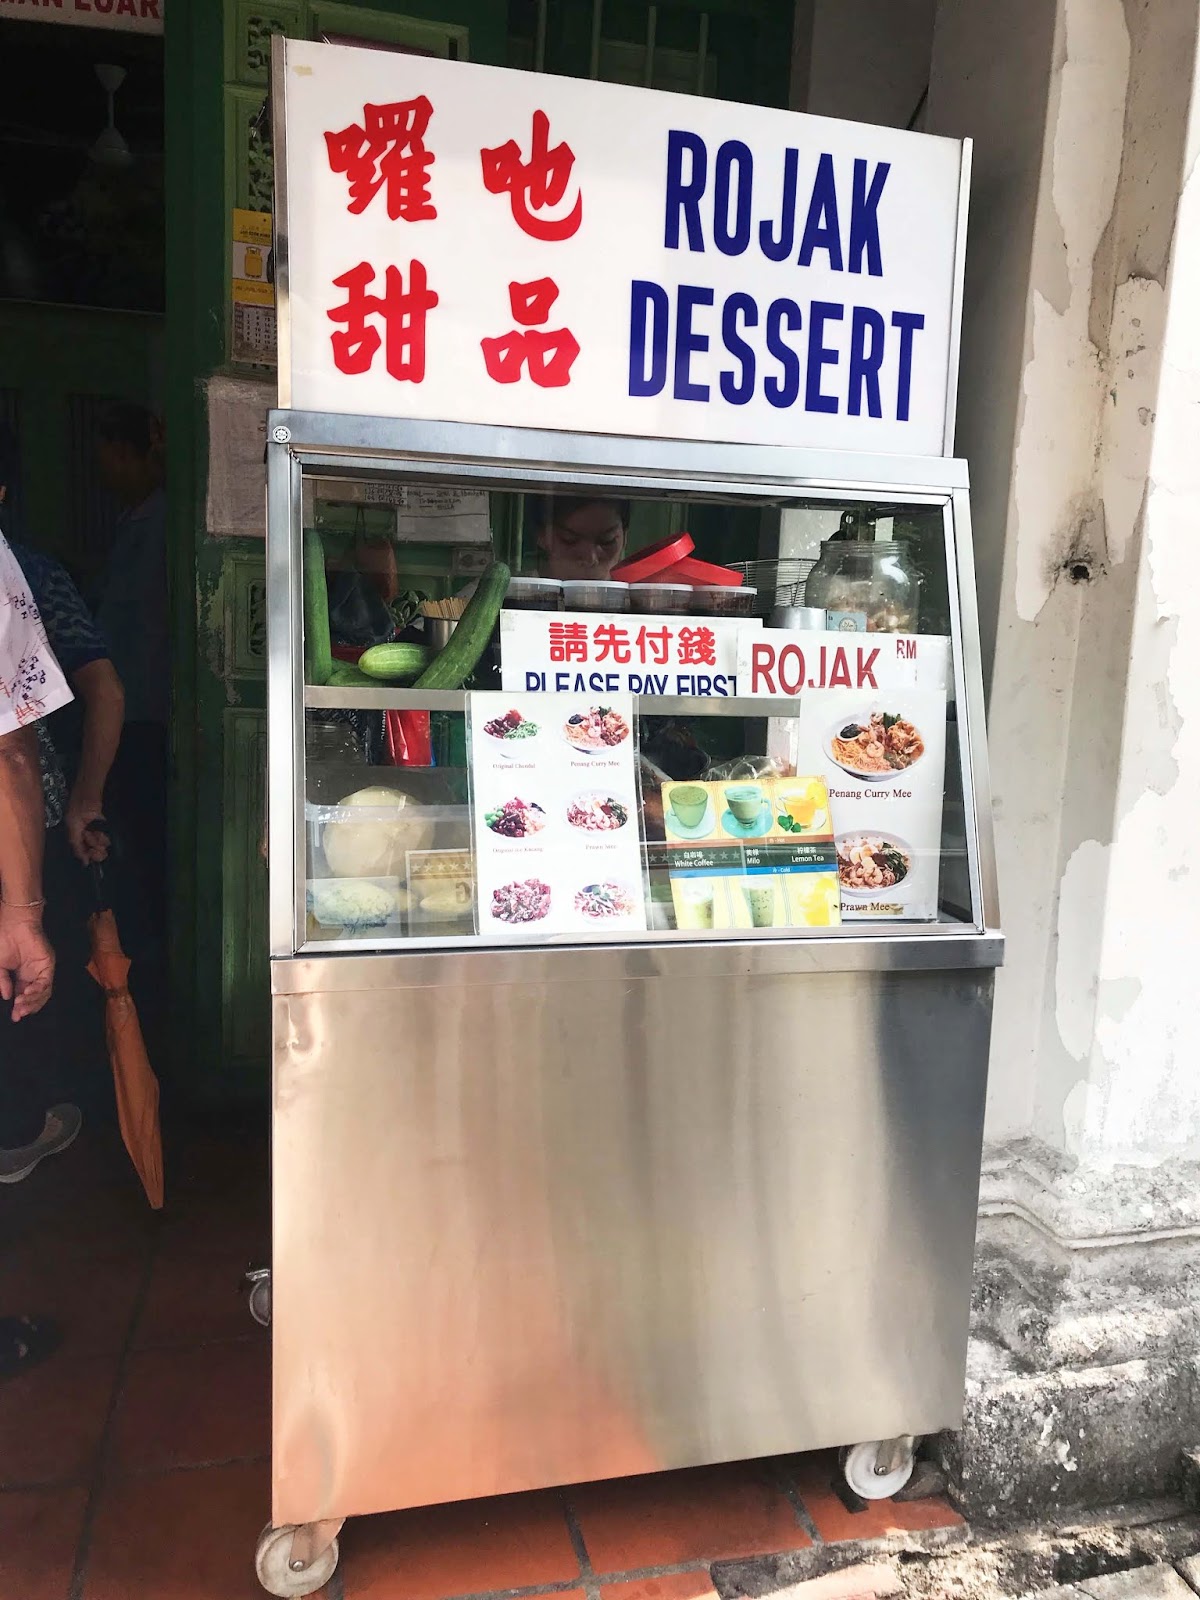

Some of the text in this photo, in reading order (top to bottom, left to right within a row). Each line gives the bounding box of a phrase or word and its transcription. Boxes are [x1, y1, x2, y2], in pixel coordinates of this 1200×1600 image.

[665, 130, 891, 277] ROJAK
[326, 259, 581, 389] 甜品
[628, 280, 925, 422] DESSERT
[549, 622, 717, 666] 請先付錢
[896, 639, 917, 660] RM
[752, 643, 881, 695] ROJAK
[525, 672, 737, 696] PLEASE PAY FIRST
[828, 788, 912, 800] Penang Curry Mee
[674, 858, 714, 868] White Coffee
[746, 857, 761, 865] Milo
[791, 854, 825, 863] Lemon Tea
[840, 902, 890, 912] Prawn Mee
